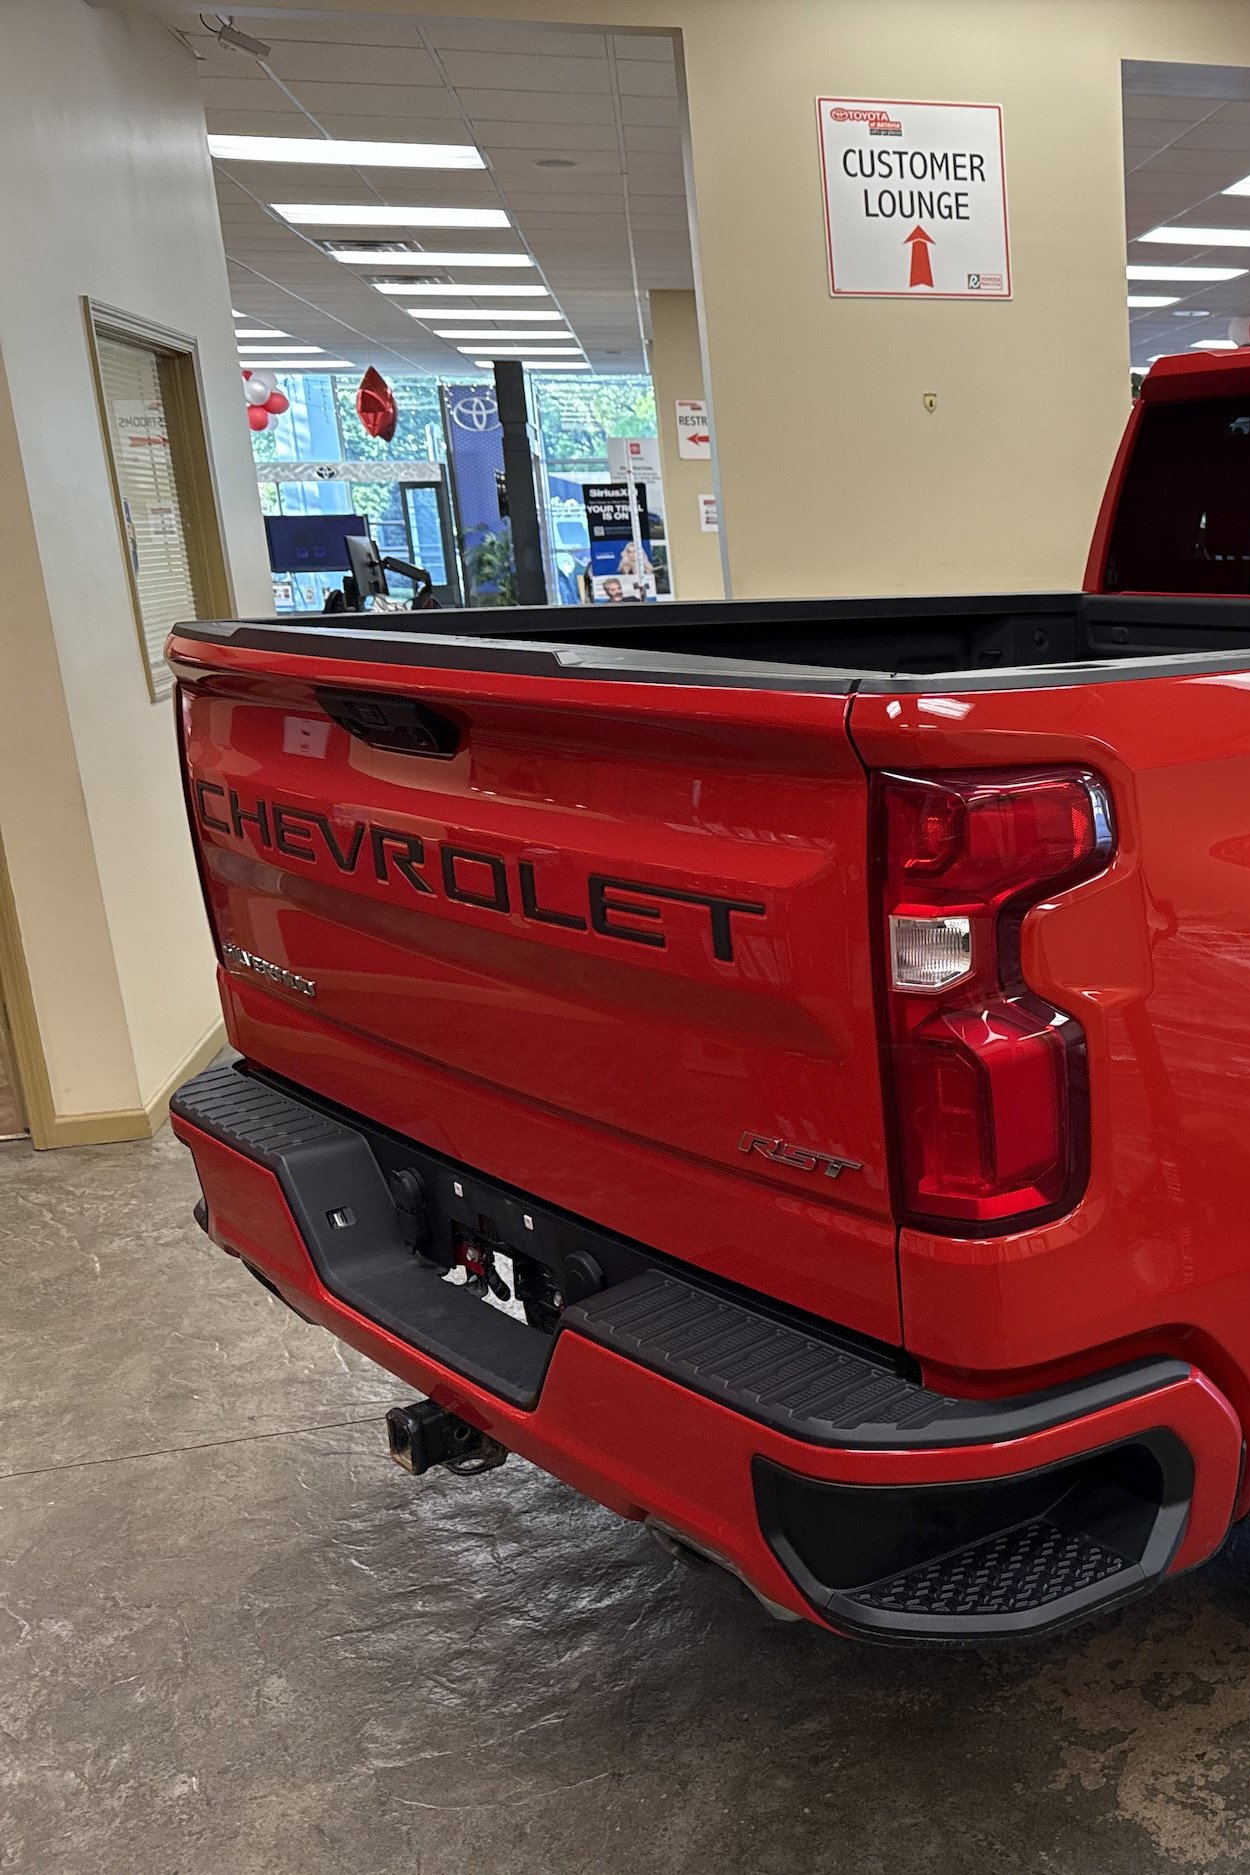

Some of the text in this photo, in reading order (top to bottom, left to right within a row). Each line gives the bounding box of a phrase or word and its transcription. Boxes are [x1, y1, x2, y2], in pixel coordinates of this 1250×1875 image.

[848, 111, 889, 122] TOYOTA
[842, 148, 986, 182] CUSTOMER
[863, 189, 971, 221] LOUNGE
[588, 488, 639, 498] SiriusX
[586, 504, 614, 514] YOUR
[602, 512, 630, 521] IS ON
[197, 778, 767, 963] CHEVROLET
[738, 1130, 865, 1179] RST
